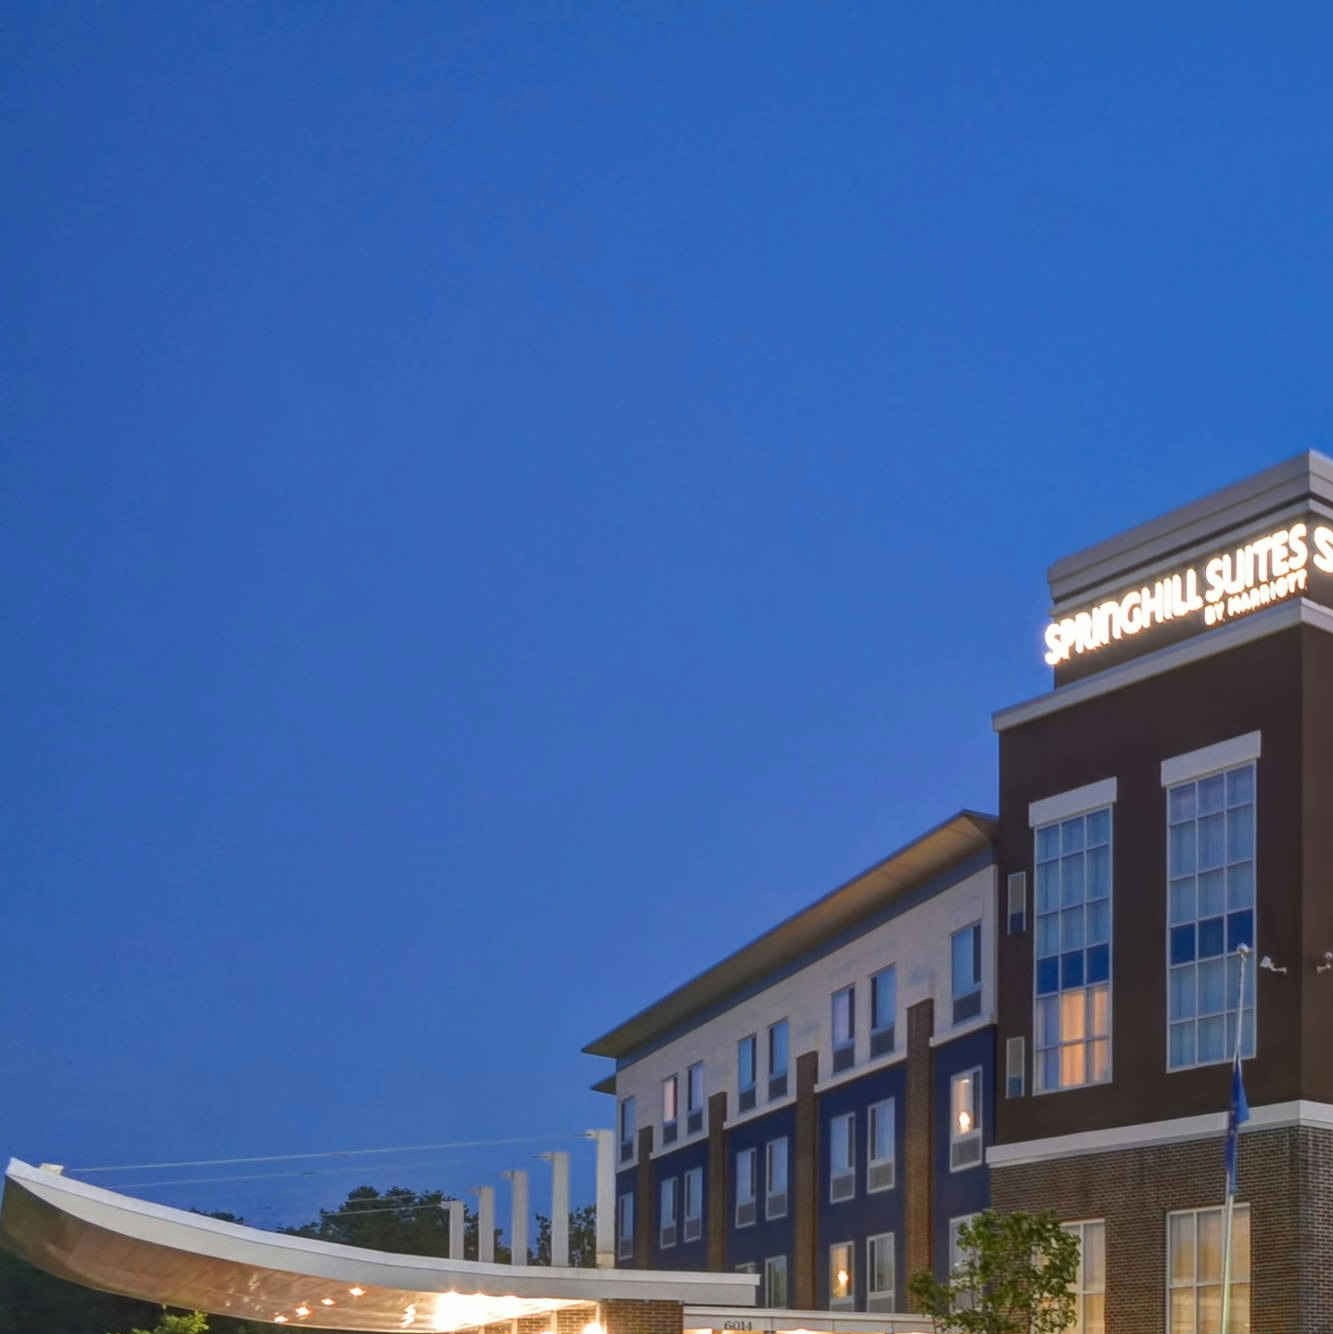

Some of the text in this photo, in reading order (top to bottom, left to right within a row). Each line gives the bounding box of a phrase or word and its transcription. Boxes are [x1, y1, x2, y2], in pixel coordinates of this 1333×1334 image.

[1044, 523, 1307, 665] SPRINGHILL SUITES
[1203, 568, 1308, 626] BY MARRIOTT
